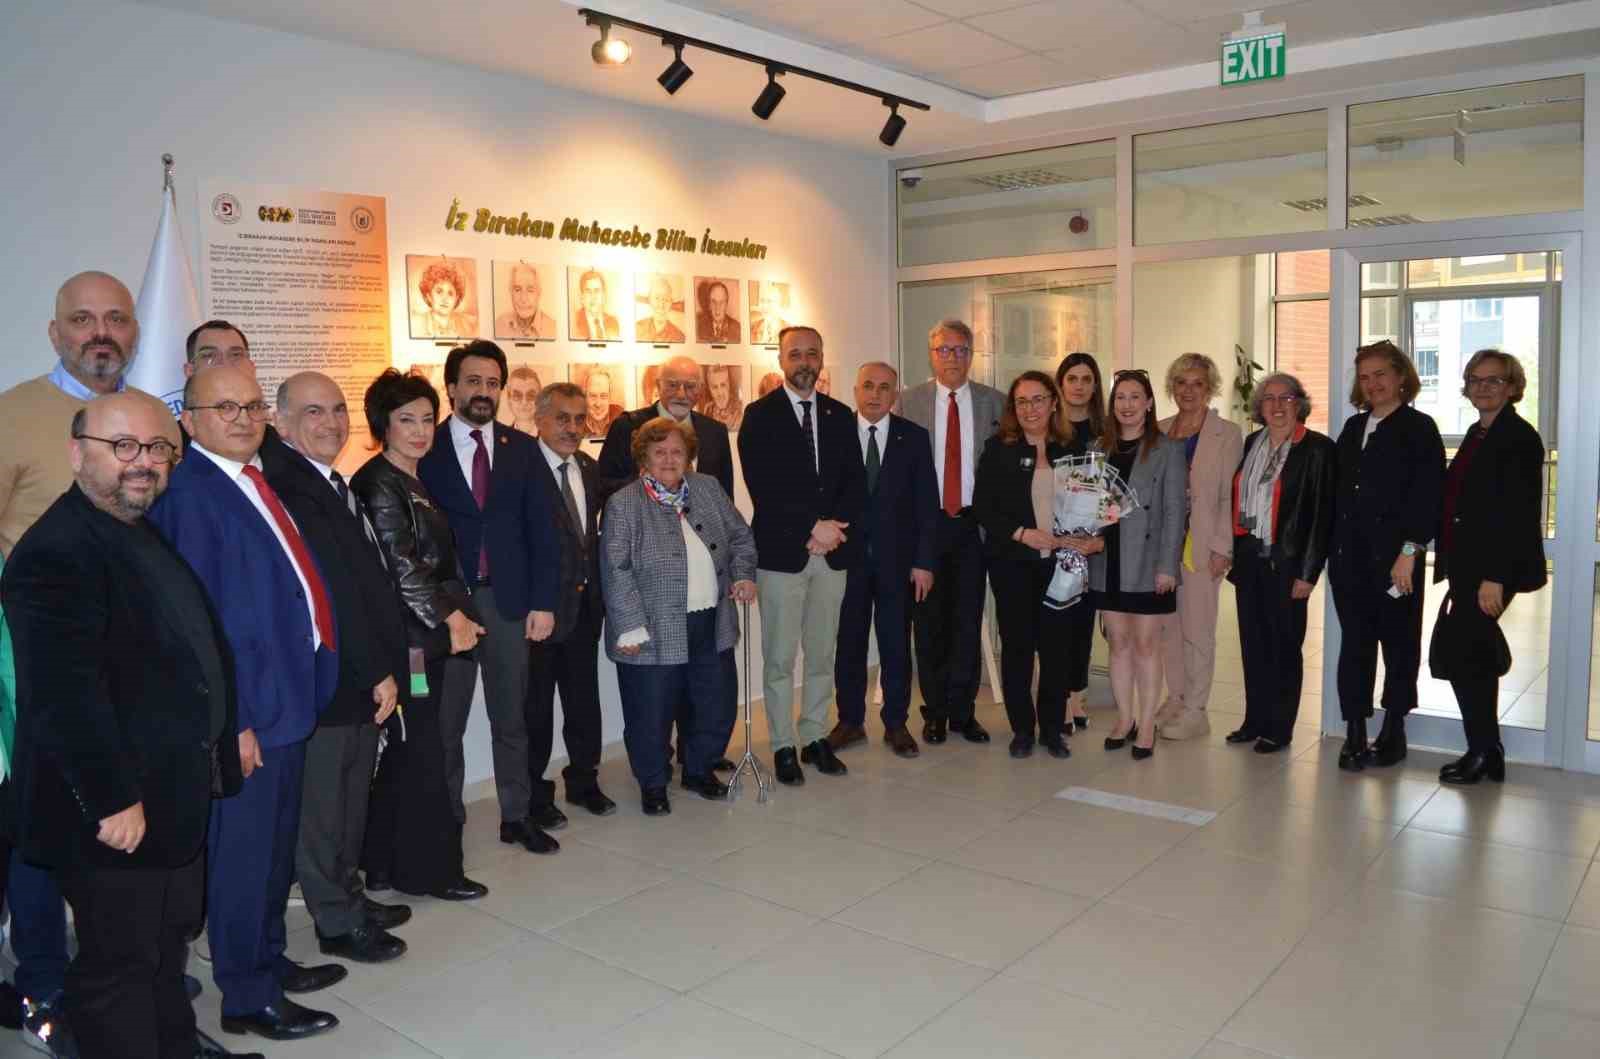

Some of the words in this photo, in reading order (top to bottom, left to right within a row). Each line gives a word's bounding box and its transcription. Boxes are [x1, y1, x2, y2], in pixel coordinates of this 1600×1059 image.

[1223, 36, 1283, 82] EXIT
[445, 196, 469, 231] İz
[473, 207, 555, 240] Bırakan
[559, 216, 651, 249] Muhasebe
[655, 227, 697, 253] Bilim
[701, 227, 768, 260] İnsanları
